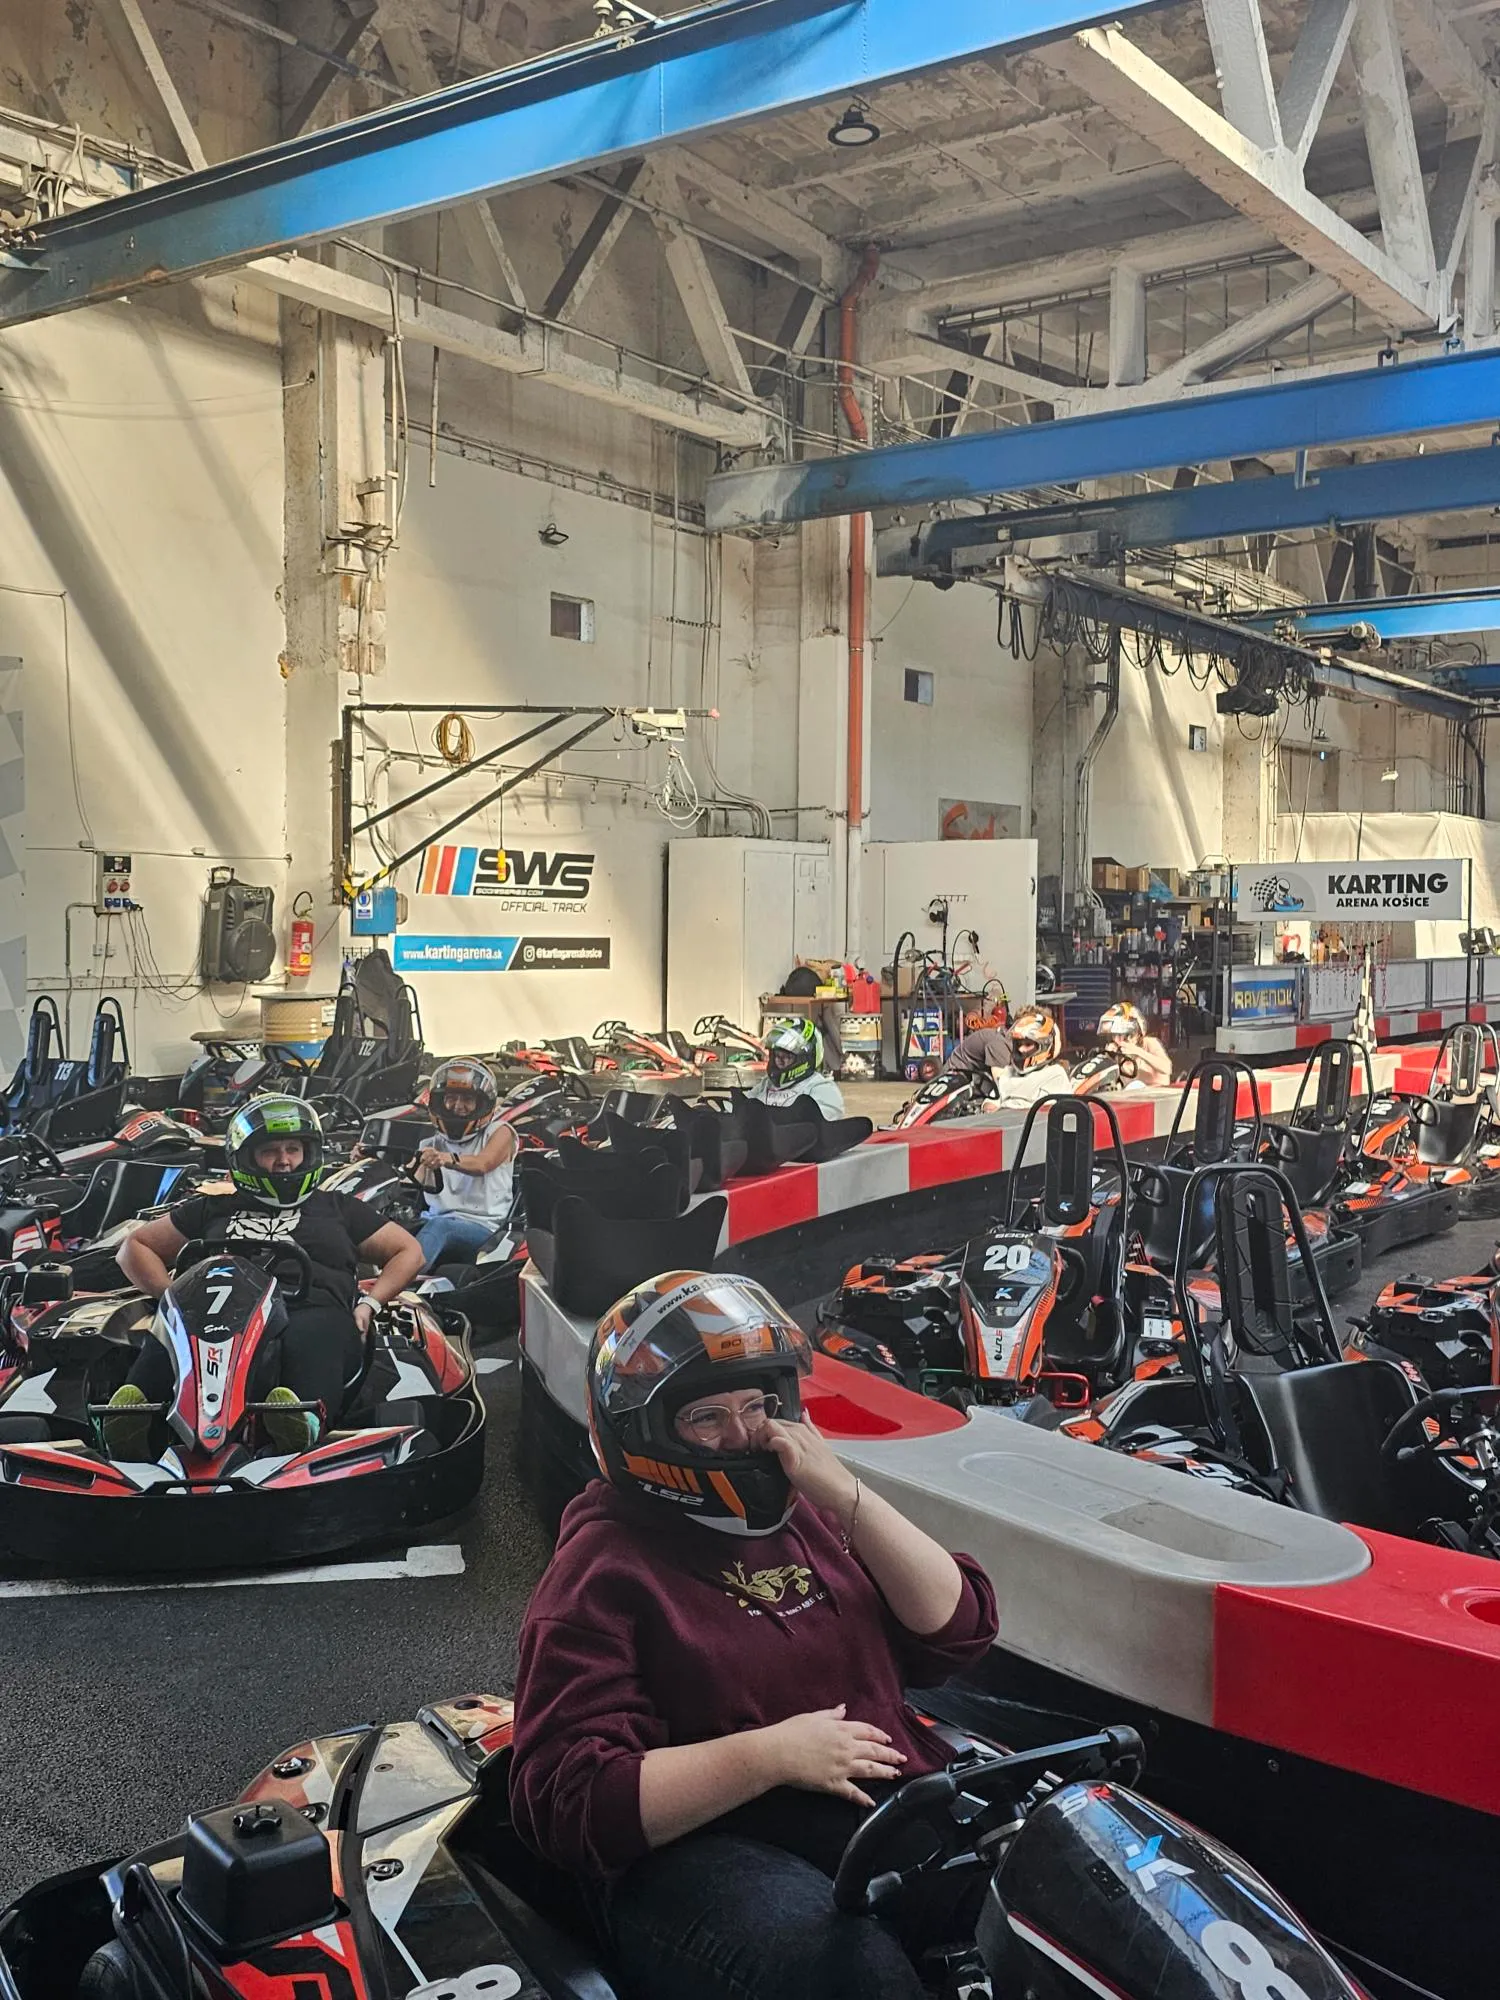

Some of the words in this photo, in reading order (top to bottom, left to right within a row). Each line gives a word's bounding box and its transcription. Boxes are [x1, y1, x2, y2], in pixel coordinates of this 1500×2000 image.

[475, 848, 595, 899] SWS
[1327, 872, 1449, 894] KARTING
[501, 901, 549, 912] OFFICIAL
[552, 902, 588, 912] TRACK
[1336, 897, 1379, 907] ARENA
[1382, 894, 1430, 908] KOŠICE
[403, 944, 503, 962] www.kartingarena.sk
[923, 1082, 948, 1097] 10
[983, 1244, 1032, 1272] 20
[206, 1285, 232, 1315] 7
